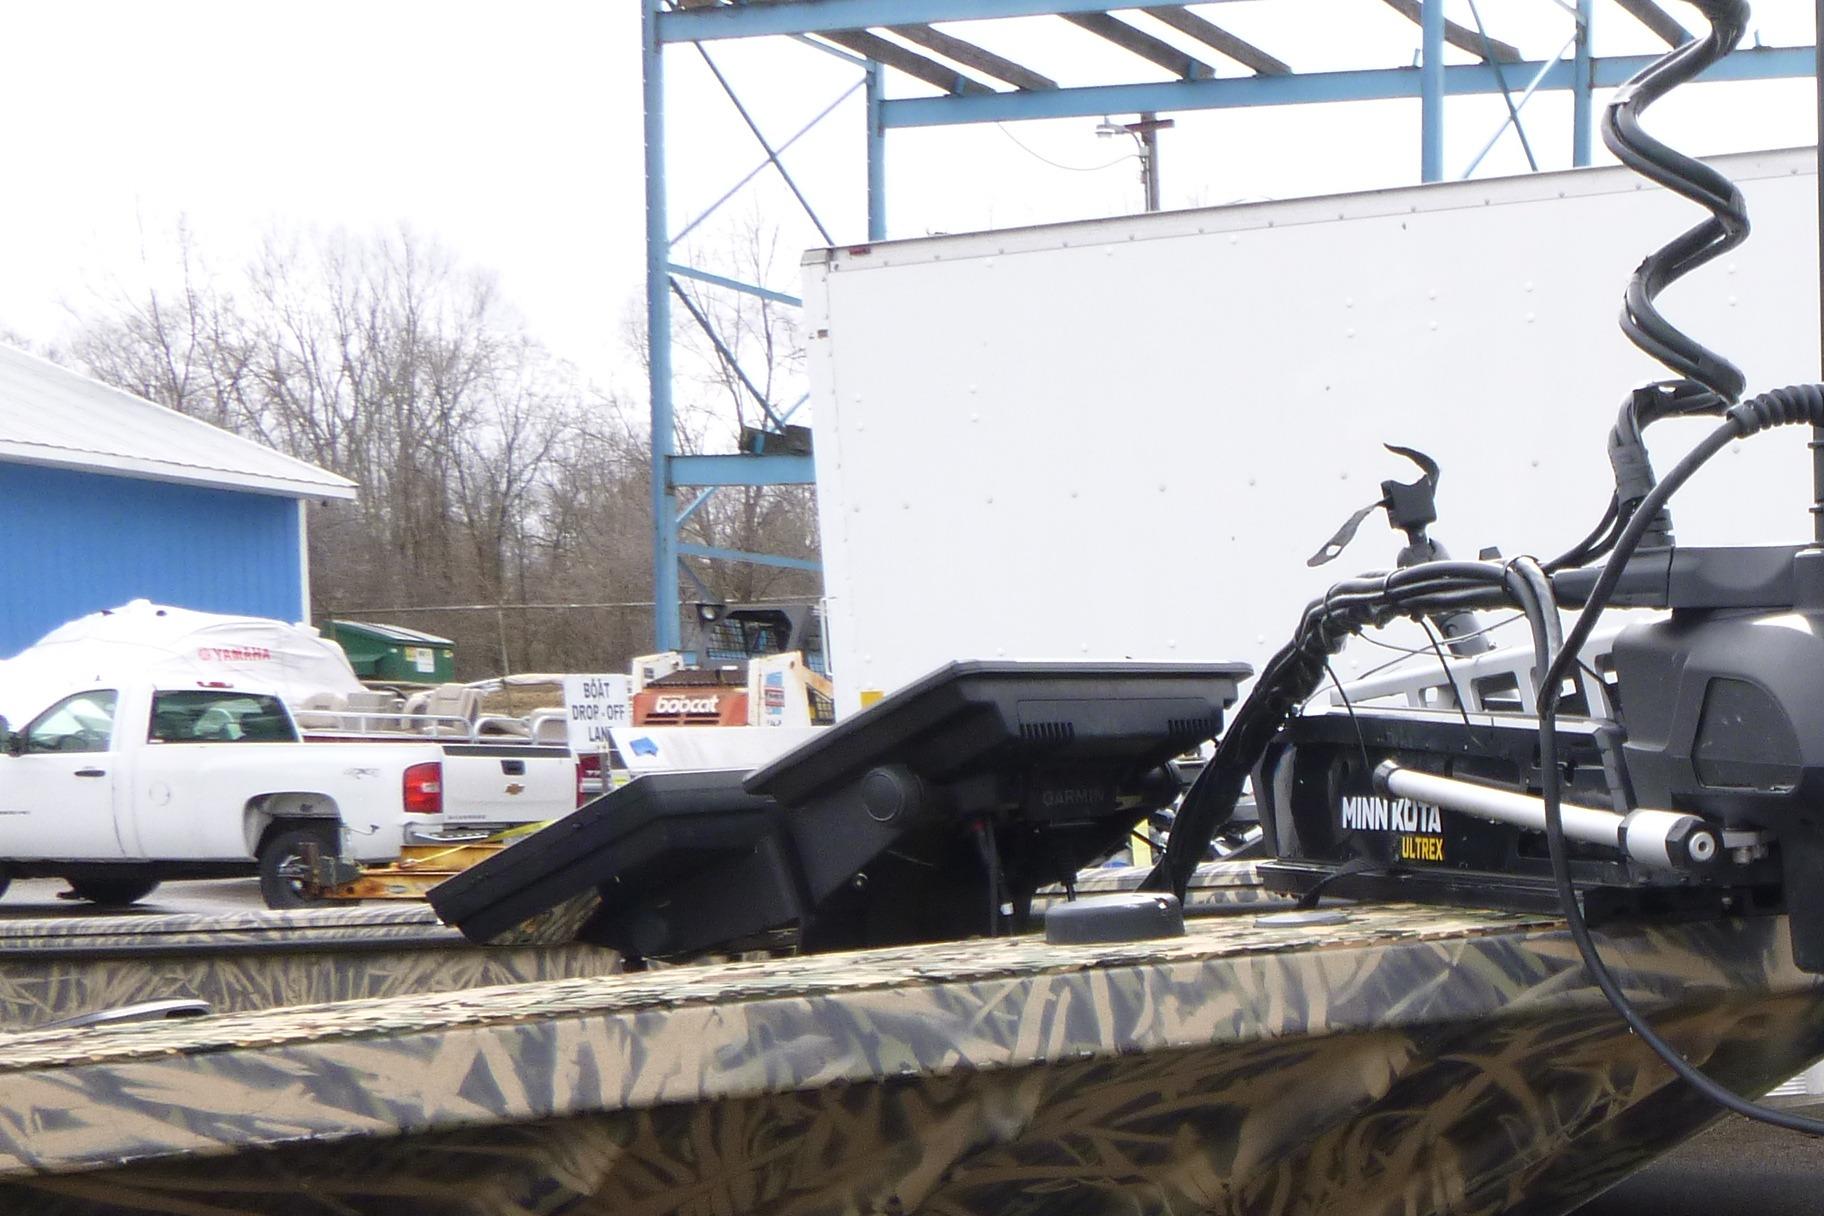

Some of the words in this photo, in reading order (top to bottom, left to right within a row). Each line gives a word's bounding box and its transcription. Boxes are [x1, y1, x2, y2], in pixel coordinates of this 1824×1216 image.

[655, 694, 720, 713] bobcat
[588, 726, 614, 742] LAN
[1342, 796, 1388, 831] MINN
[1391, 797, 1442, 833] KOTA
[1402, 836, 1443, 861] ULTREX
